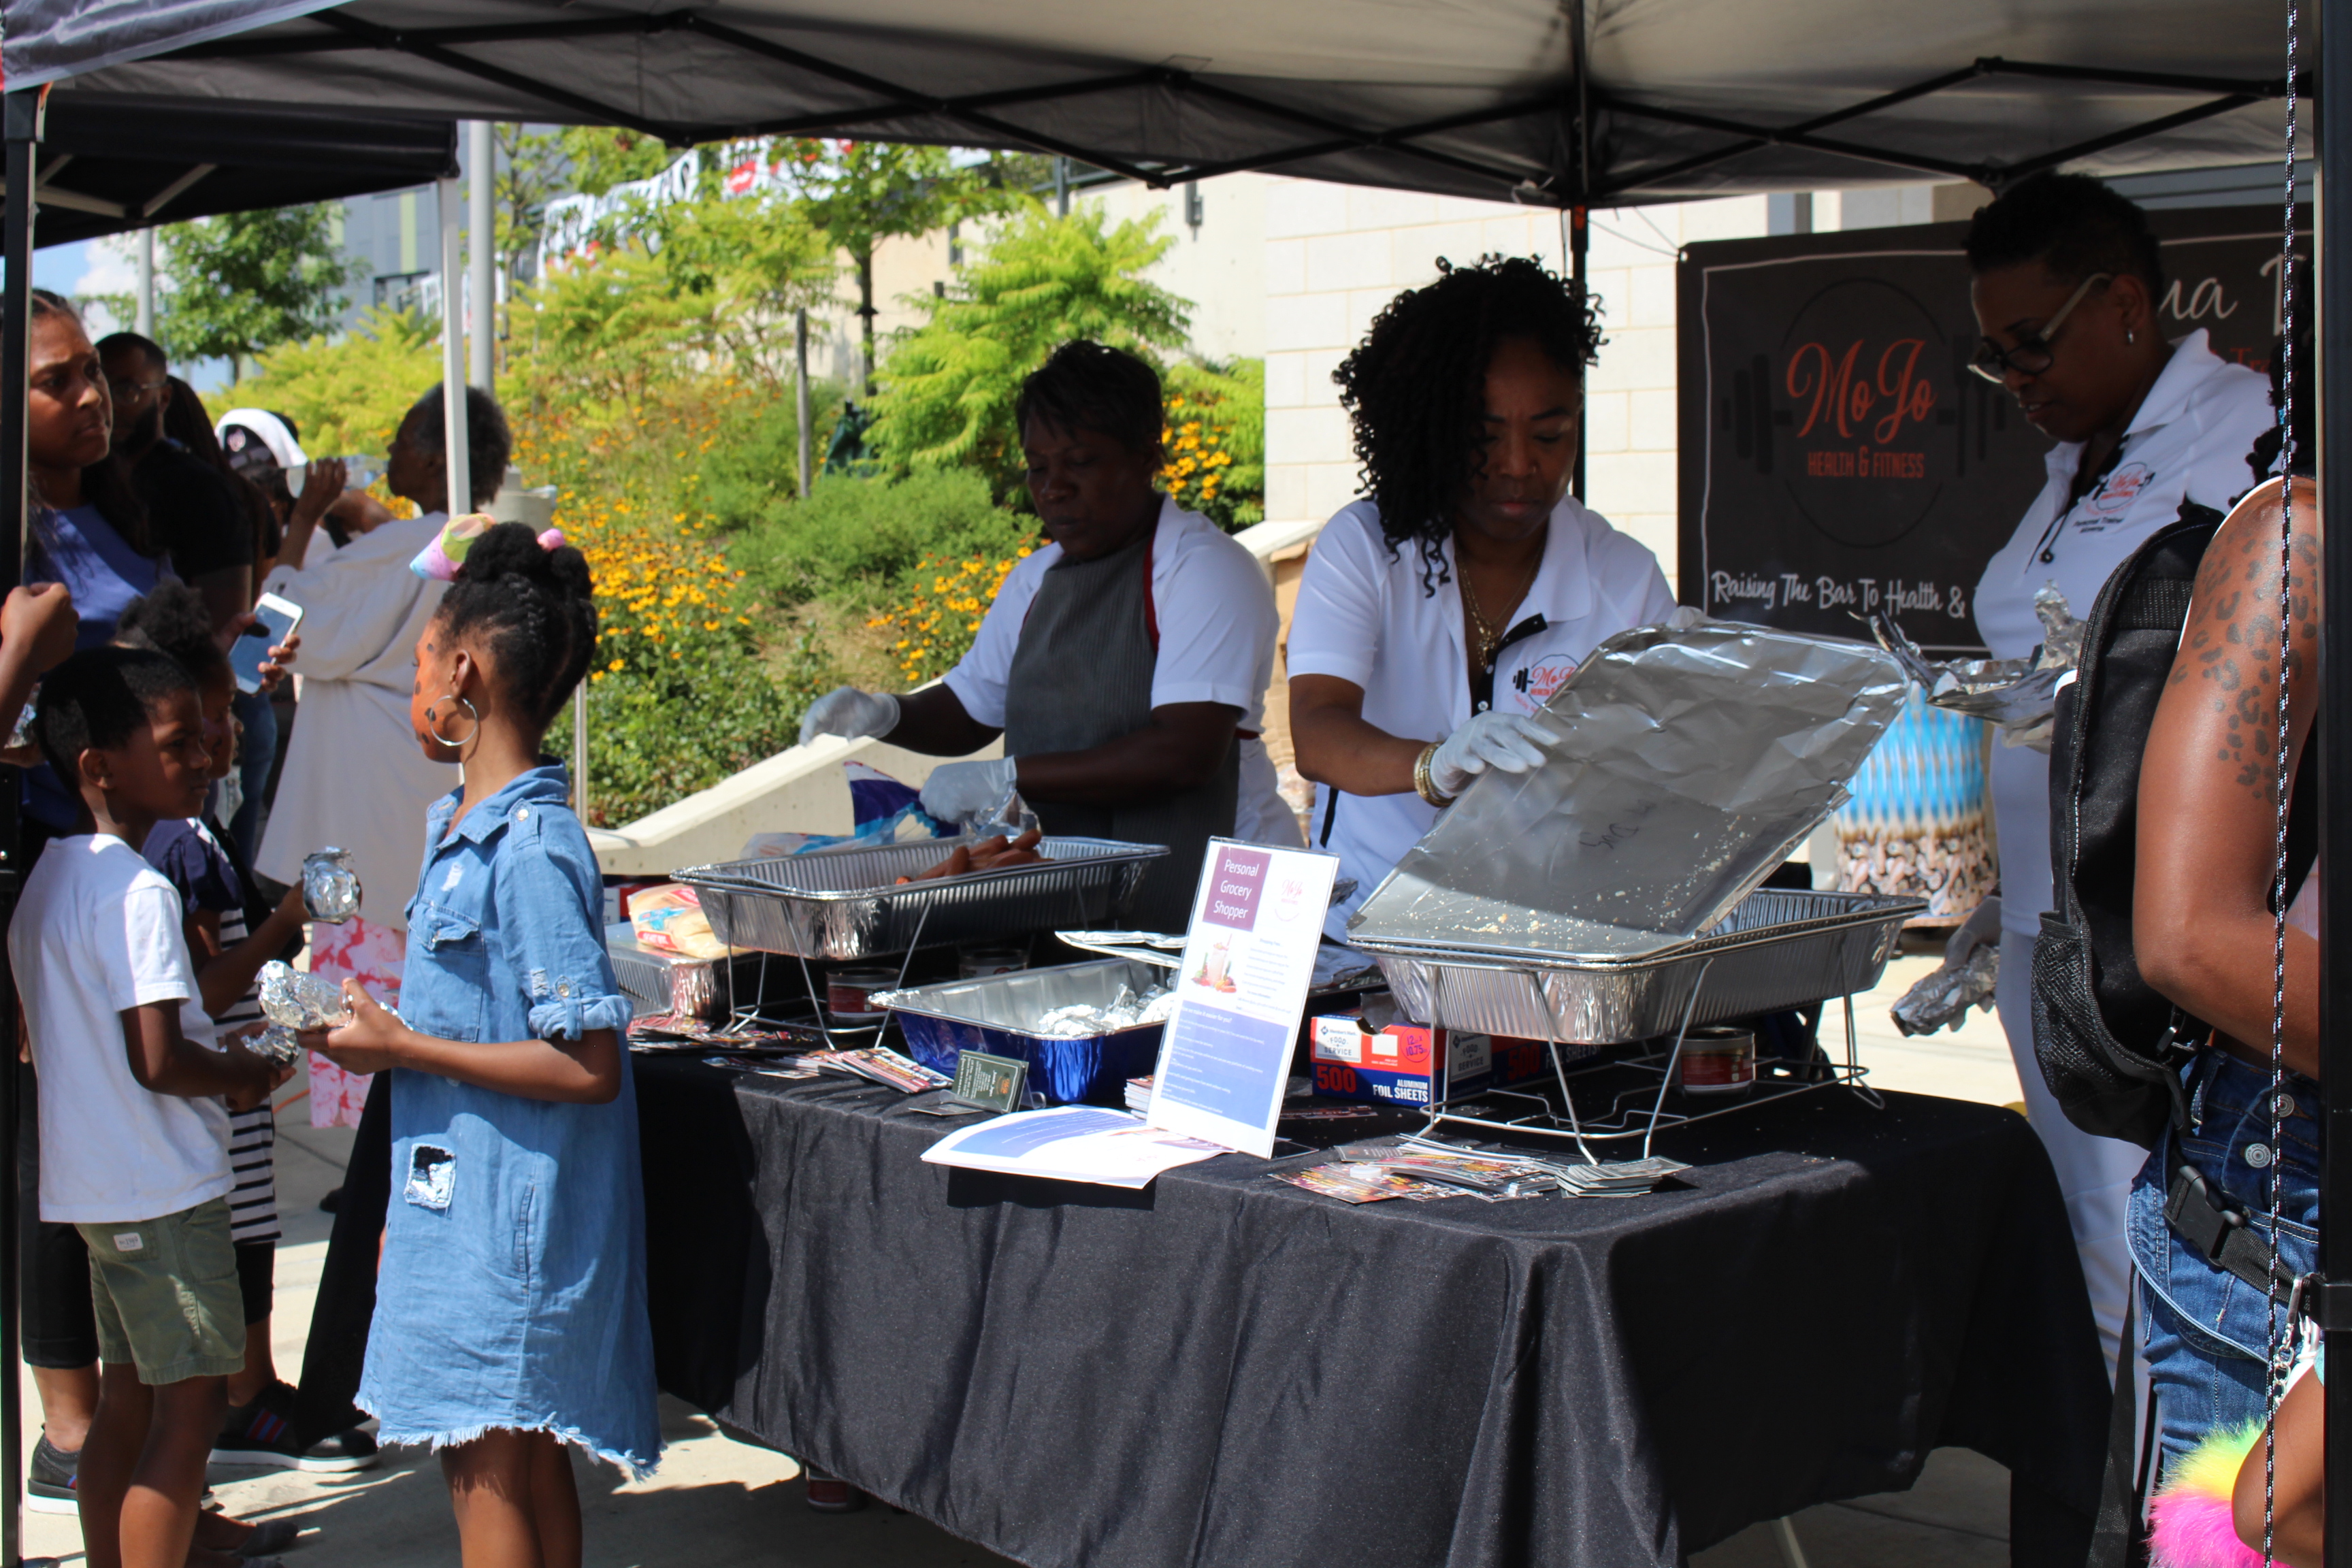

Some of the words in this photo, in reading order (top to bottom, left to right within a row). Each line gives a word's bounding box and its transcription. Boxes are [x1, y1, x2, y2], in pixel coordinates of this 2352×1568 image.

[1786, 338, 1938, 444] MoJo
[1808, 451, 1855, 477] HEALTH
[1859, 444, 1869, 477] &
[1873, 452, 1925, 478] FITNESS
[1711, 570, 1776, 610] Raising
[1780, 573, 1812, 607] The
[1816, 575, 1857, 610] Bar
[1858, 578, 1880, 612] To
[1884, 579, 1944, 617] Health
[1947, 585, 1966, 619] &
[1224, 859, 1260, 877] Personal
[1220, 879, 1252, 901] Grocery
[1213, 900, 1248, 921] Shopper
[1330, 1036, 1346, 1045] FOOD
[1463, 1044, 1479, 1054] FOOD
[1324, 1047, 1352, 1056] SERVICE
[1458, 1056, 1484, 1071] SERVICE
[1507, 1043, 1540, 1081] 500
[1566, 1044, 1598, 1063] SHEETS
[1317, 1065, 1356, 1093] 500
[1396, 1079, 1428, 1090] ALUMINUM
[1373, 1084, 1393, 1098] FOIL
[1394, 1087, 1428, 1102] SHEETS
